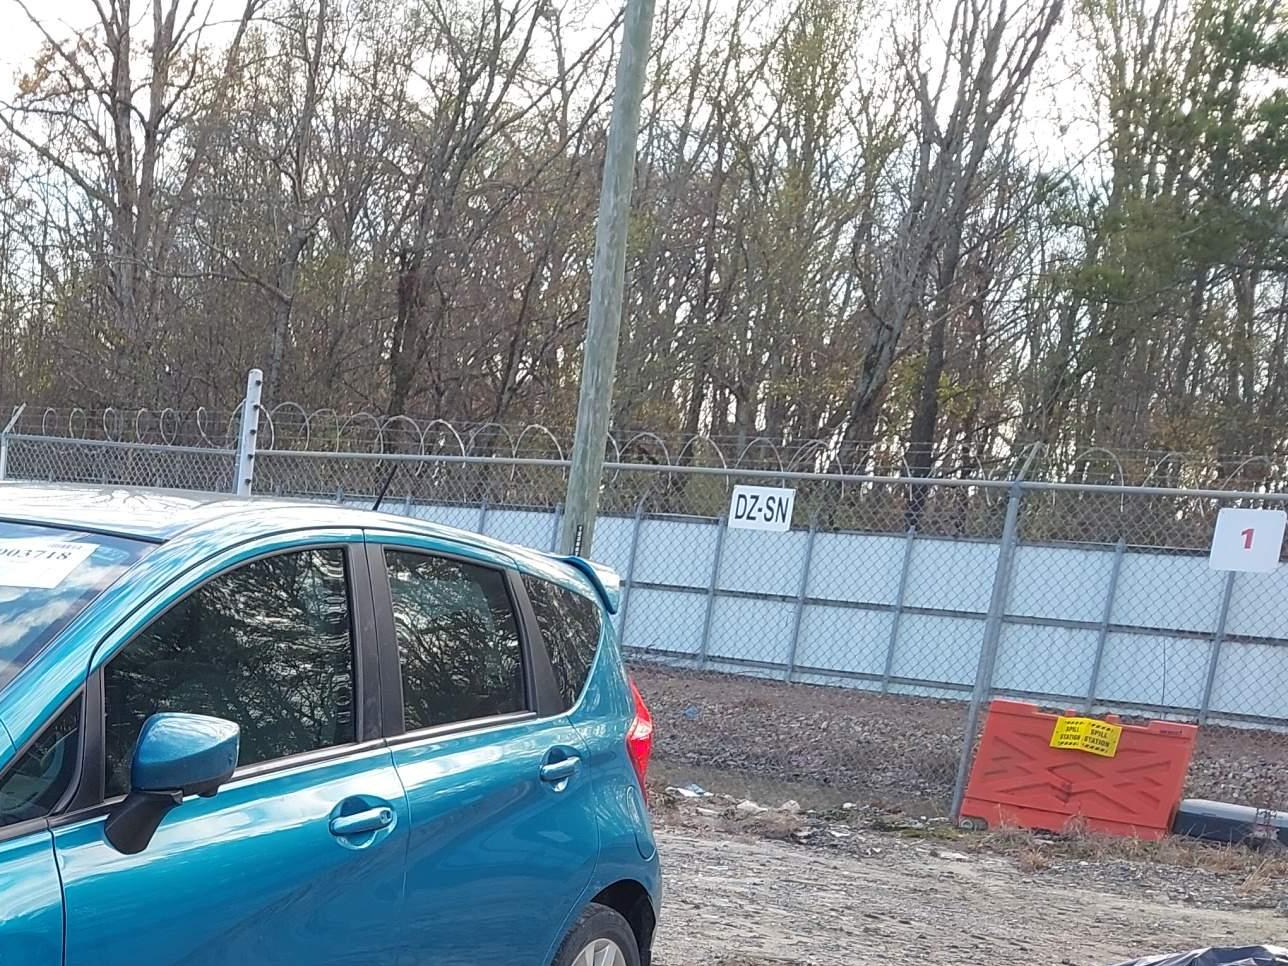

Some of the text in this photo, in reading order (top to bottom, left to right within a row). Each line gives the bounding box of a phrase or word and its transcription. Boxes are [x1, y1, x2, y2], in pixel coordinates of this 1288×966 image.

[734, 494, 789, 523] DZ-SN
[1241, 528, 1255, 549] 1
[1084, 735, 1110, 747] STATION
[1090, 729, 1108, 738] SPILL
